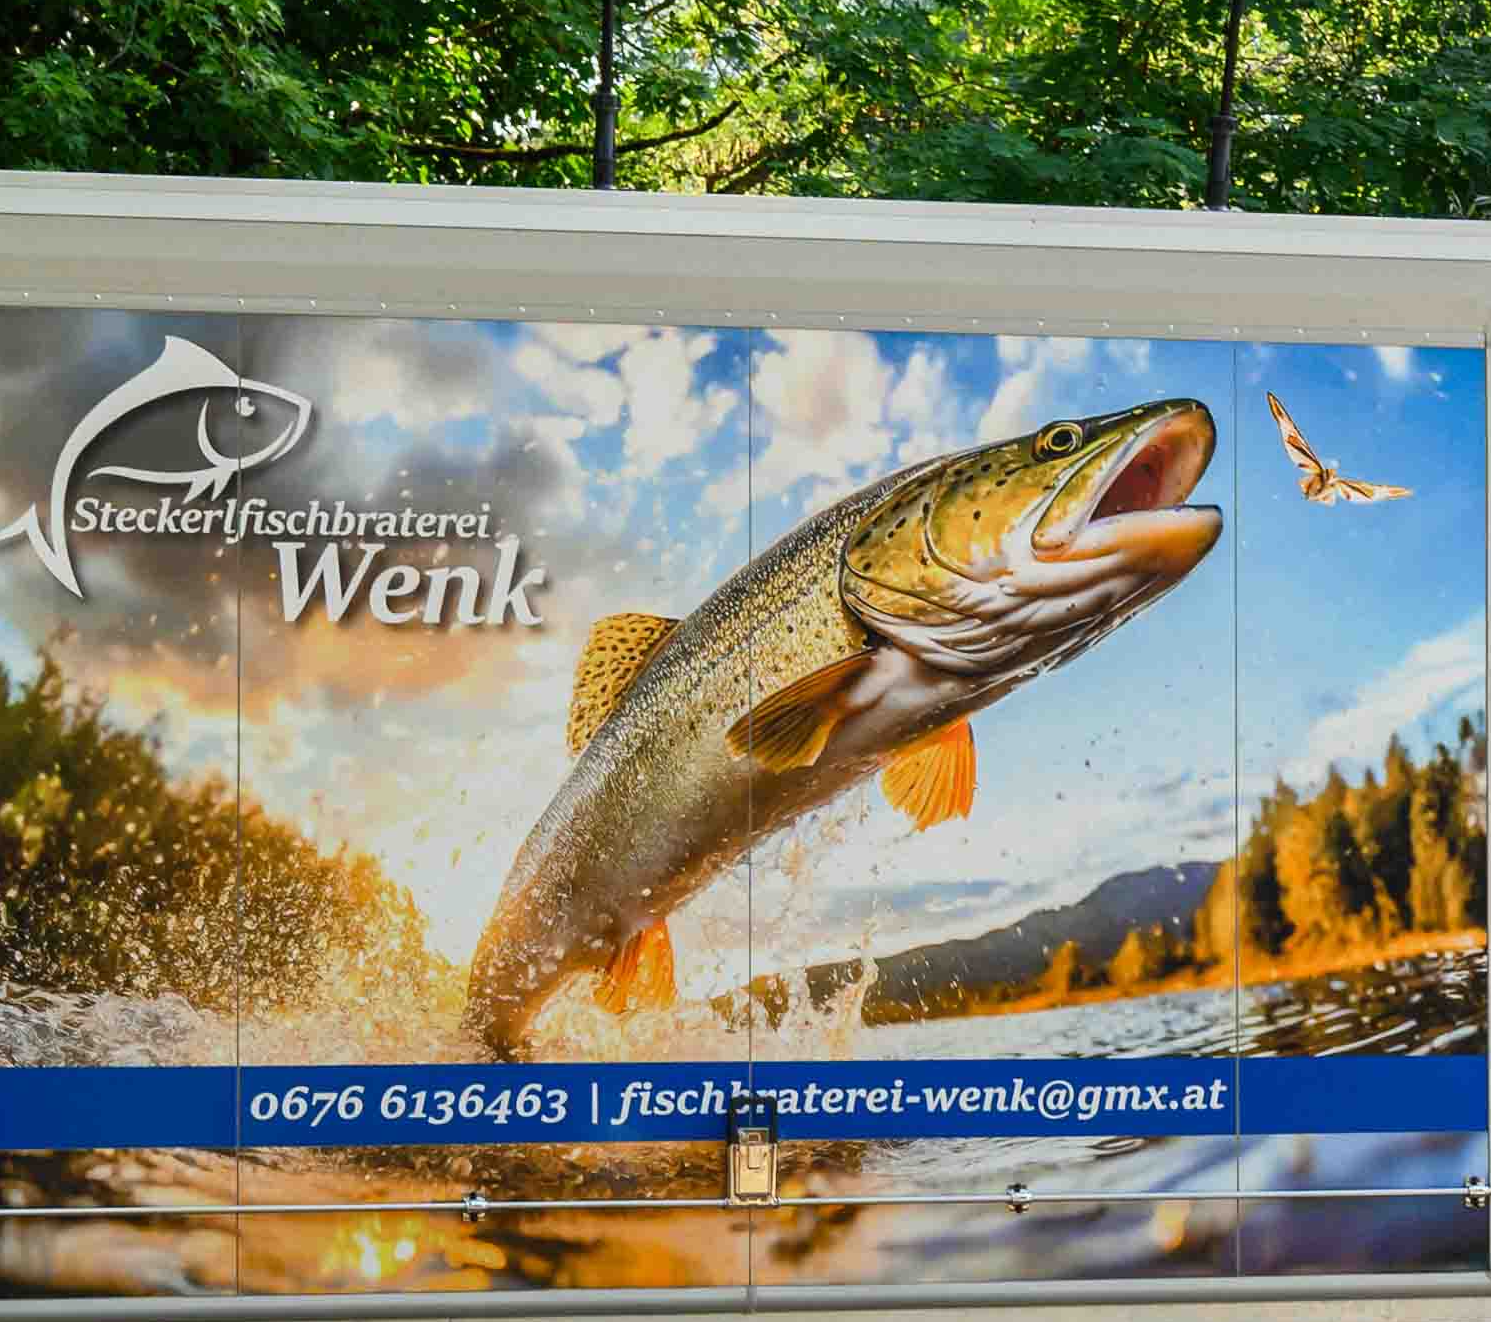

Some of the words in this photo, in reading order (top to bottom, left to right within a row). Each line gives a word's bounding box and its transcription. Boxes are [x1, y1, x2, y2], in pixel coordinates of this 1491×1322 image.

[71, 497, 492, 544] Steckerlfischbraterei
[272, 536, 547, 627] Wenk
[251, 1084, 364, 1123] 0676
[380, 1080, 569, 1123] 6136463
